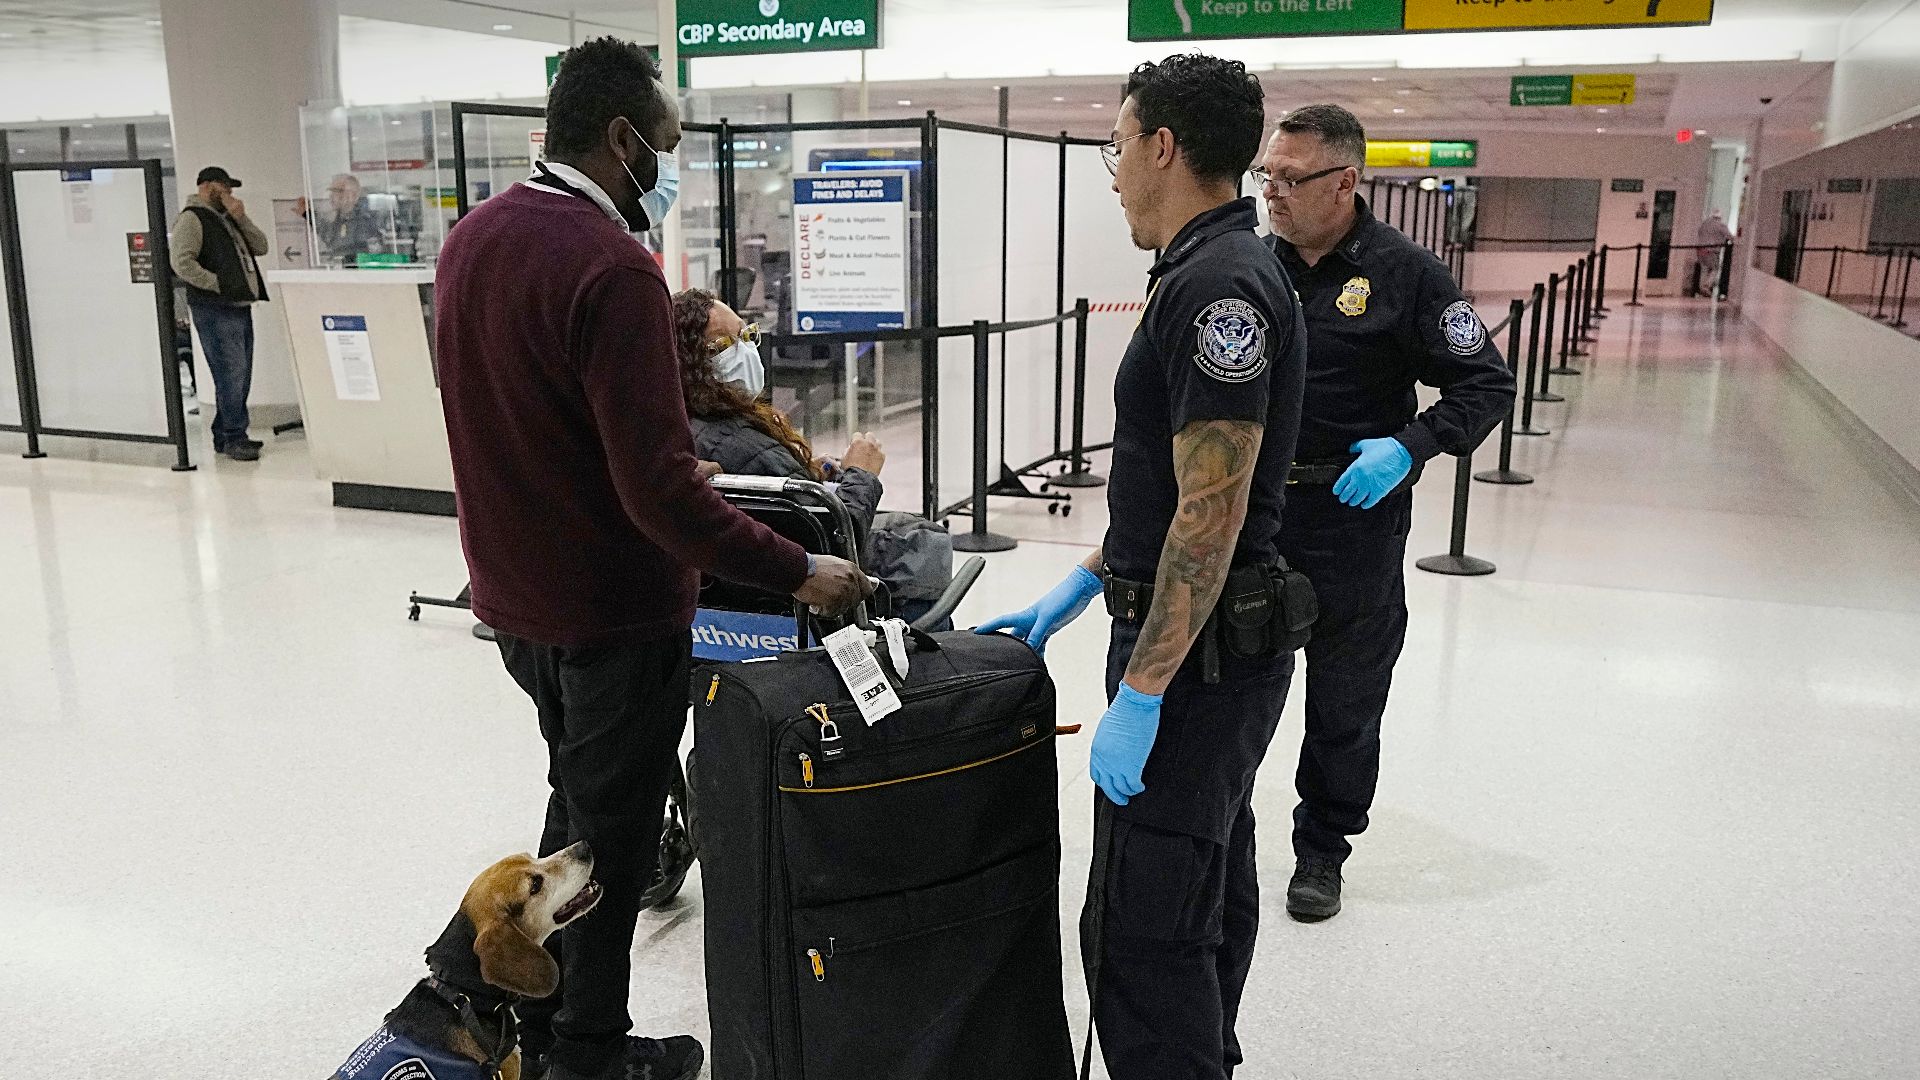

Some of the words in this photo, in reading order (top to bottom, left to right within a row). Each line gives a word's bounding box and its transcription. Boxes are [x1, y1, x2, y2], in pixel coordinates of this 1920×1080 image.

[1201, 0, 1248, 17] Keep
[1253, 0, 1272, 13] to
[1279, 0, 1309, 12] the
[1315, 0, 1353, 11] Left
[678, 24, 715, 45] CBP
[717, 18, 815, 43] Secondary
[818, 17, 866, 37] Area
[836, 190, 853, 199] AND
[854, 189, 884, 198] DELAYS
[800, 213, 812, 280] DECLARE
[861, 682, 887, 701] BWI
[344, 1028, 388, 1072] American
[347, 1033, 397, 1079] Protecting
